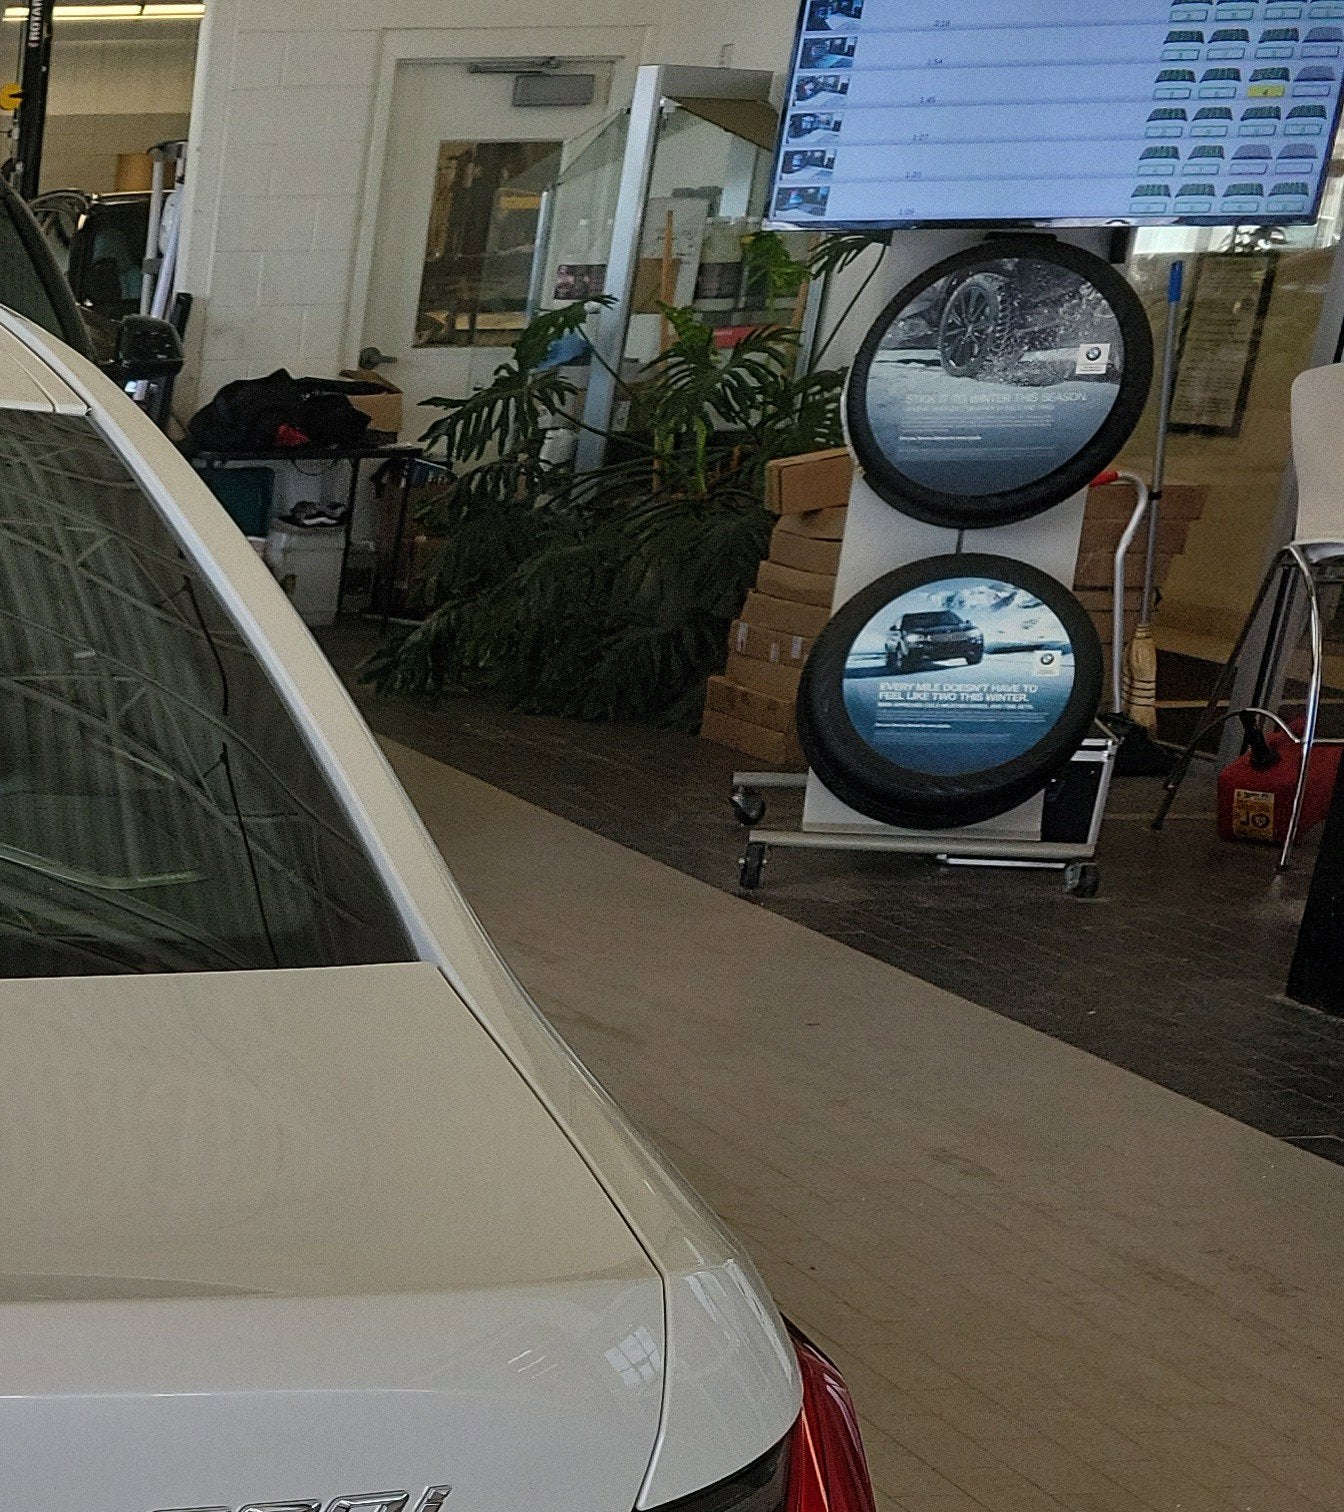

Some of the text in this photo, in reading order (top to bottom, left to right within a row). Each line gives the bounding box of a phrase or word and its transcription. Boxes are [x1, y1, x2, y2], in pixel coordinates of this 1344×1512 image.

[1022, 684, 1038, 693] TO
[879, 691, 904, 701] FEEL
[906, 692, 930, 701] LIKE
[932, 692, 957, 702] TWO
[959, 692, 984, 702] THIS
